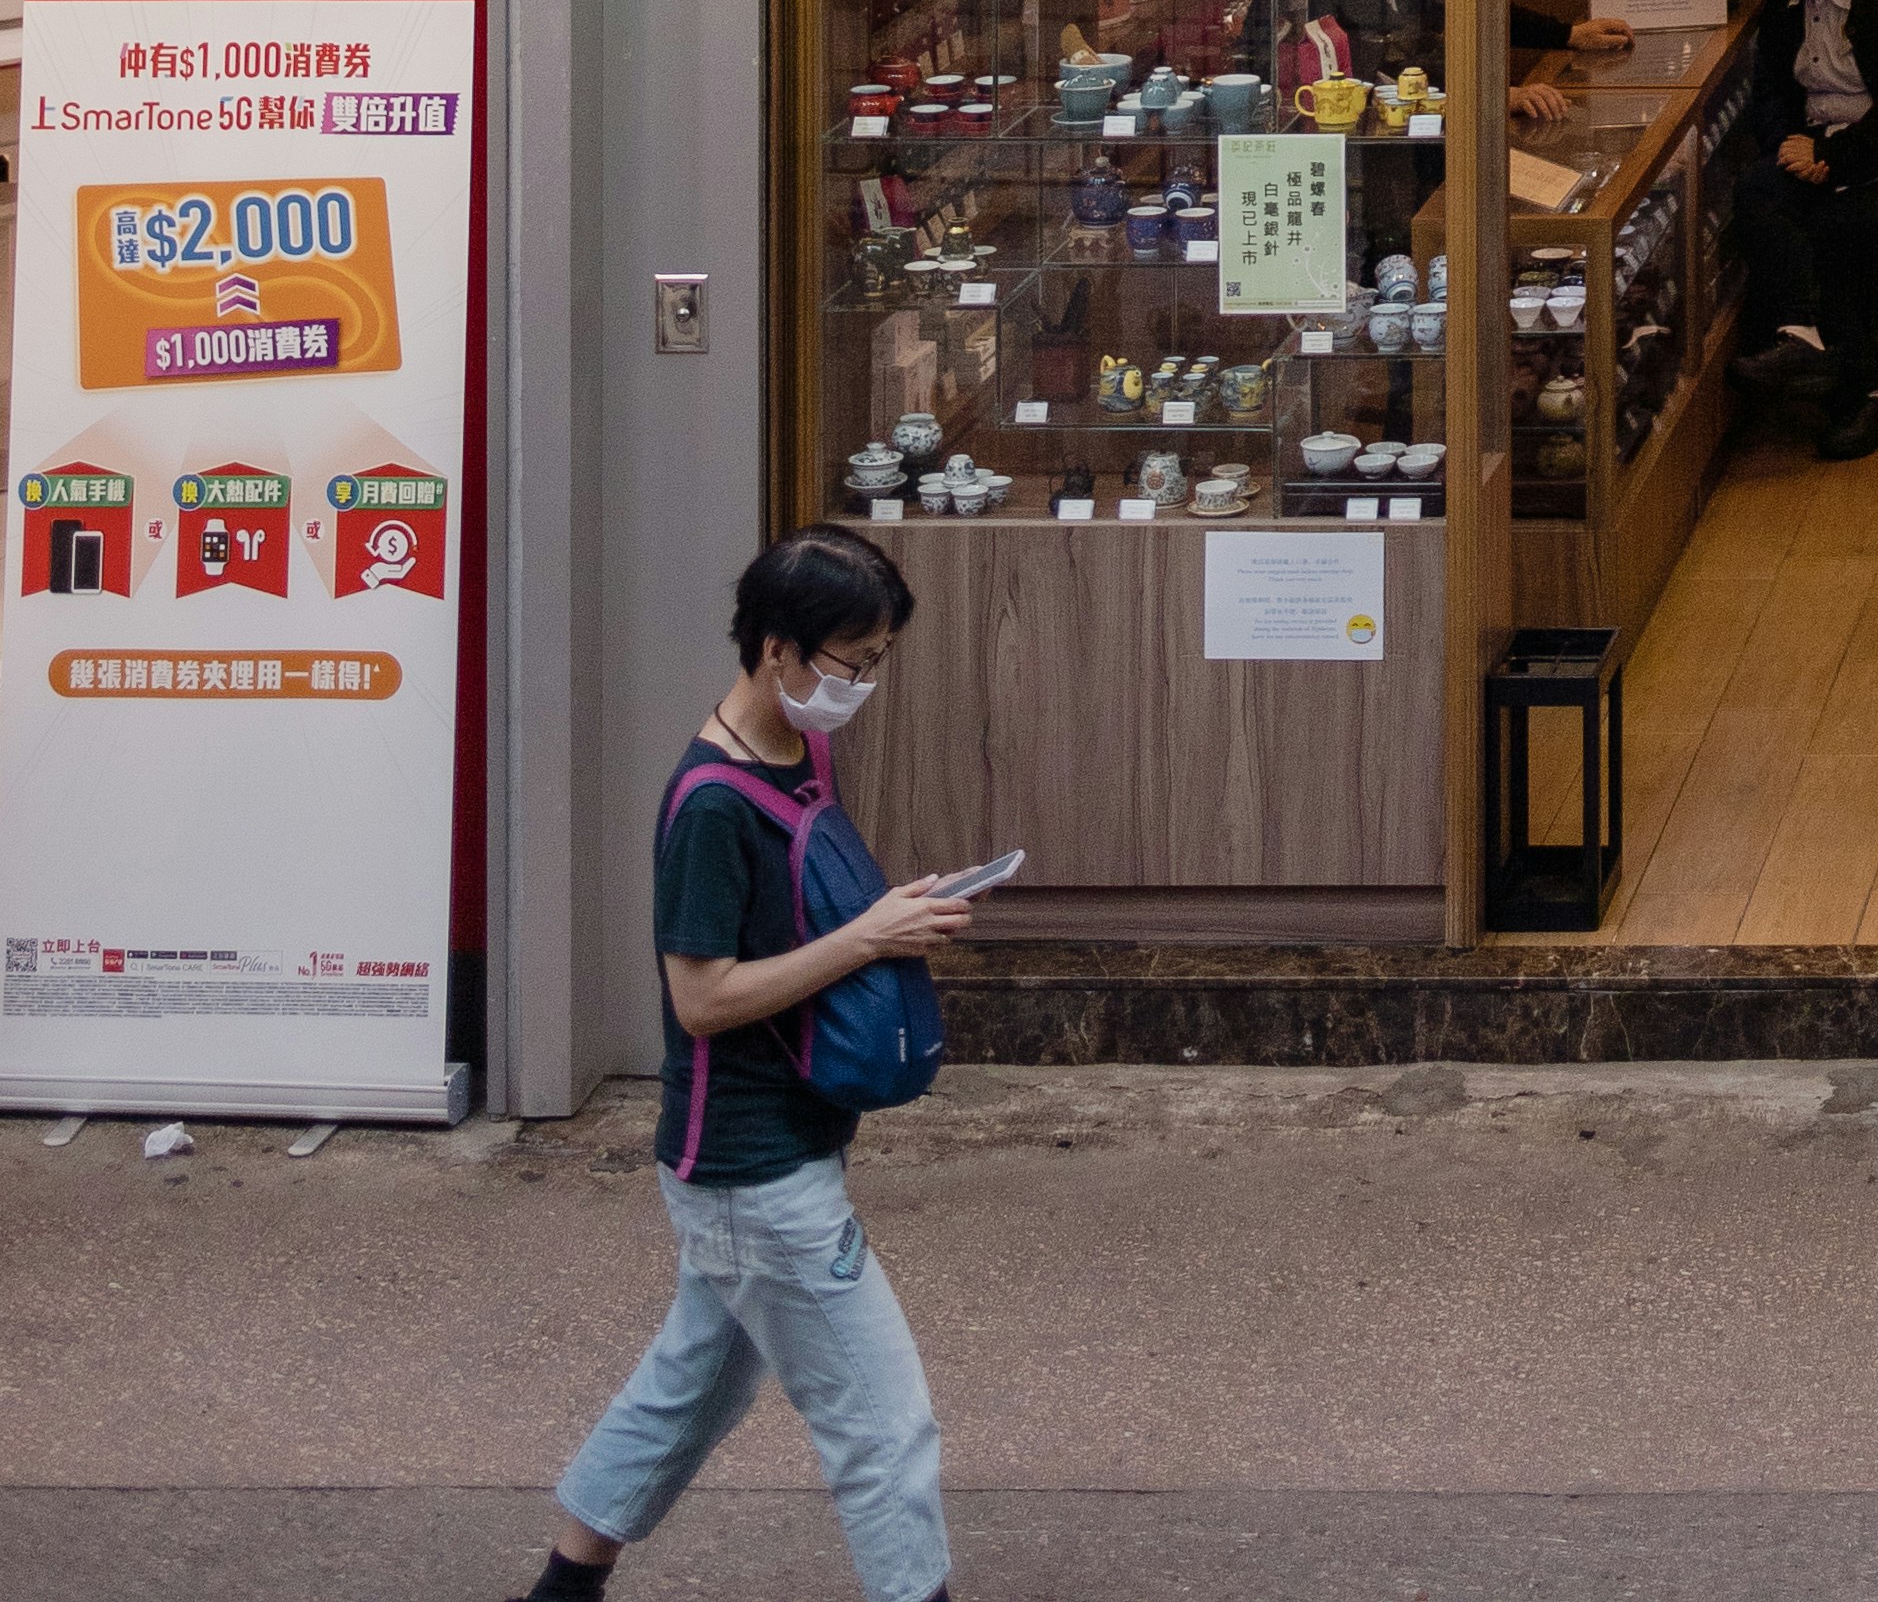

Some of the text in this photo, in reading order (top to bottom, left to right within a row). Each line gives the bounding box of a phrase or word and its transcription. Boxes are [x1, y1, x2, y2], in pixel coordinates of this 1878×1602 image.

[218, 96, 253, 131] 5G
[1286, 171, 1303, 247] 極品龍井
[1309, 161, 1326, 217] 碧螺春
[115, 191, 353, 268] 高達 $2,000
[1241, 190, 1258, 266] 現已上市
[155, 323, 330, 372] $1,000消費券
[51, 478, 127, 503] 人氣手機
[207, 479, 283, 504] 大熱配件
[41, 938, 102, 954] 立即上台
